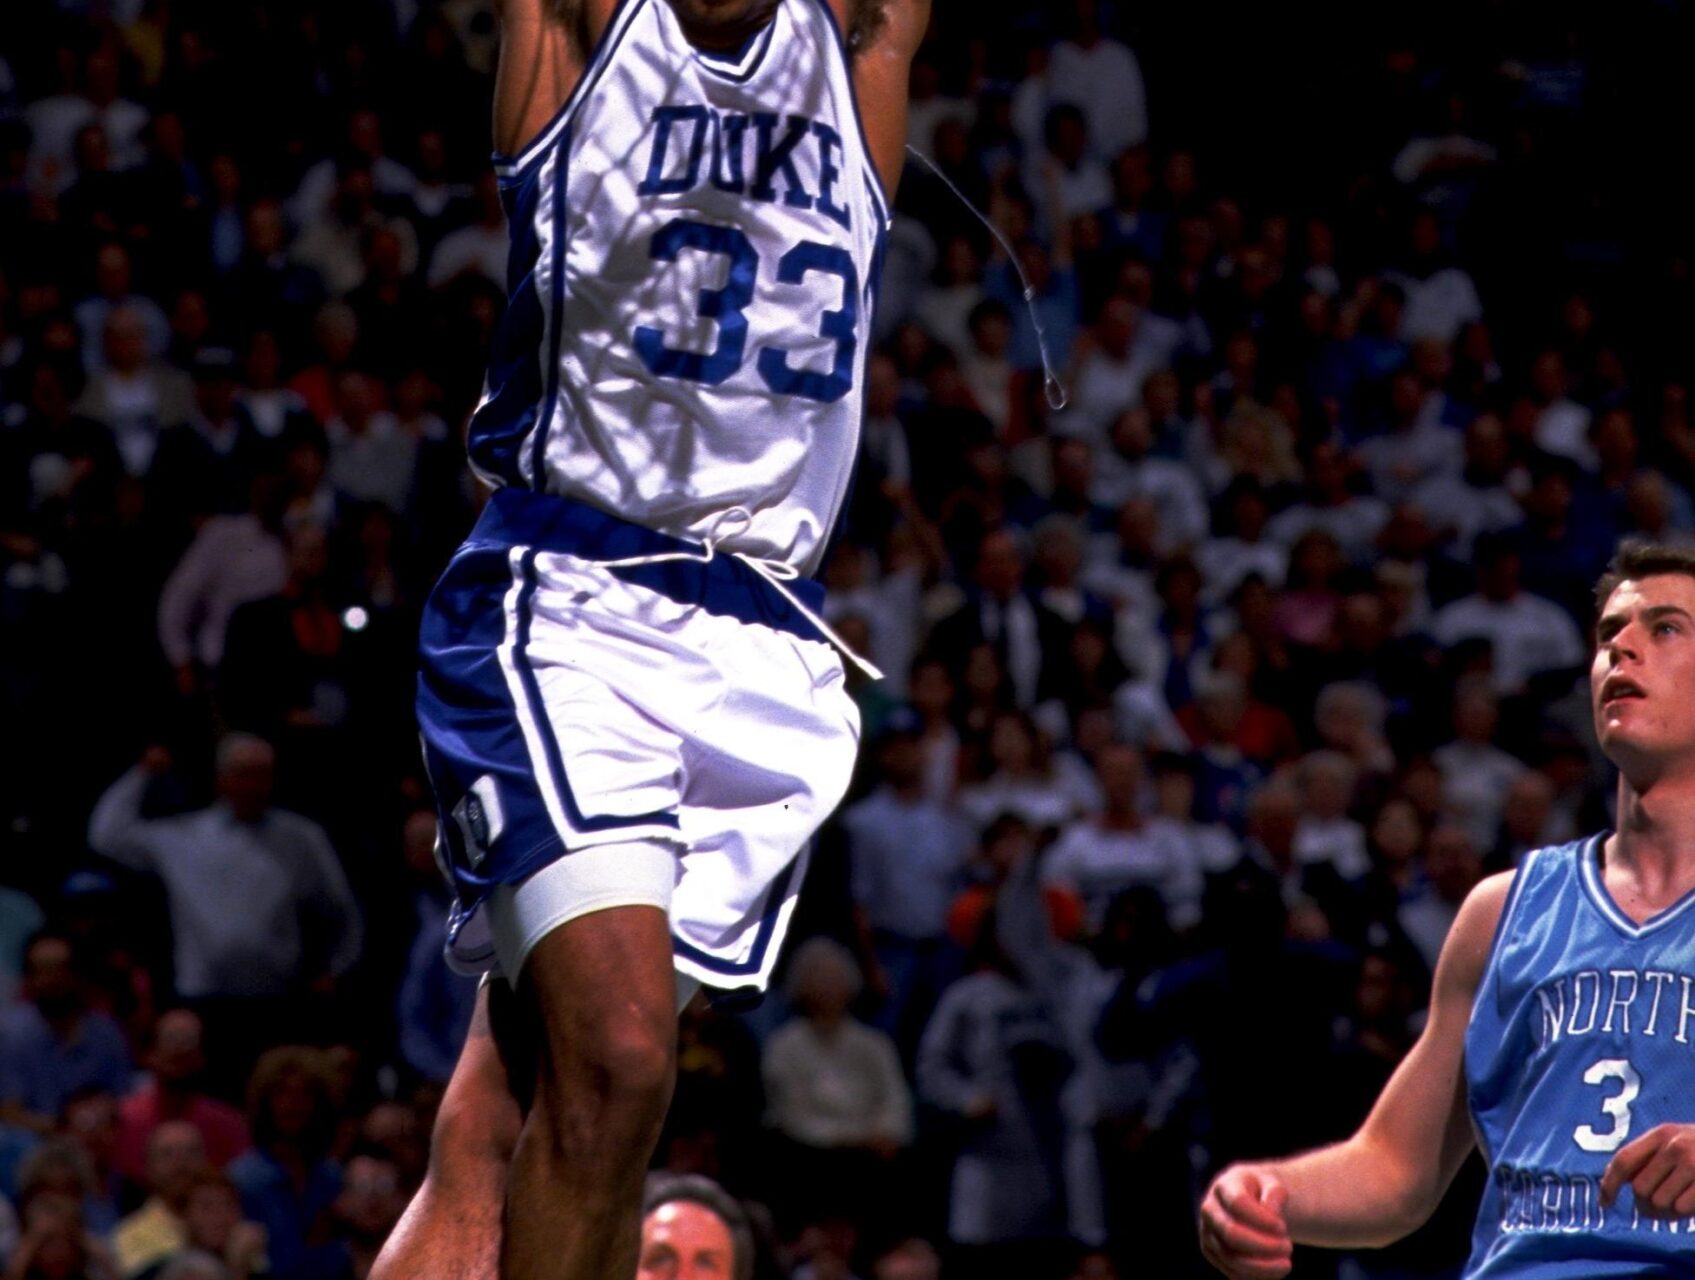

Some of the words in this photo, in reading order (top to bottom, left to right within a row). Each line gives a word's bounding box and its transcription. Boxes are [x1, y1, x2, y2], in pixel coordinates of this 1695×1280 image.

[638, 104, 851, 232] DUKE
[633, 218, 858, 403] 33
[1535, 970, 1695, 1052] NORTH
[1573, 1059, 1641, 1152] 3
